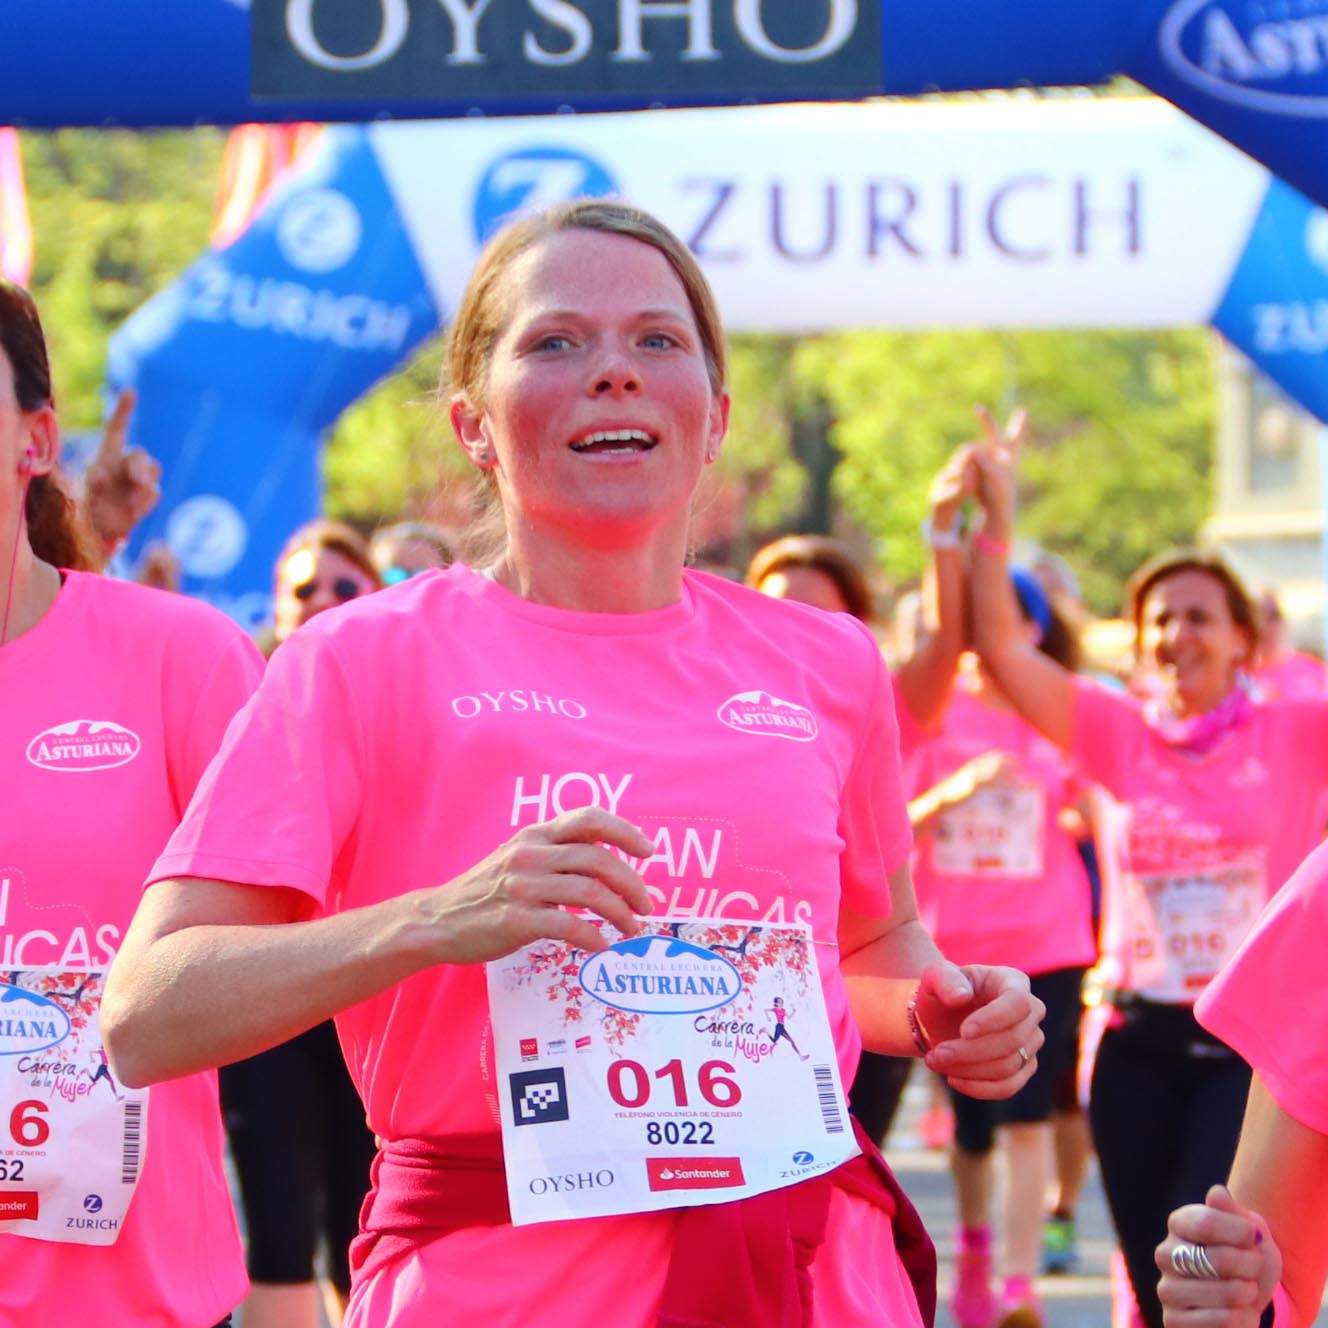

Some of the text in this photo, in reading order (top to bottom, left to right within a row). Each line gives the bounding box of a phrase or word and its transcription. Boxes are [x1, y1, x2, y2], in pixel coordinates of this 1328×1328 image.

[285, 0, 858, 70] OYSHO
[678, 172, 1142, 264] ZURICH
[187, 262, 412, 353] ZURICH
[451, 689, 587, 720] OYSHO
[729, 708, 814, 735] ASTURIANA
[36, 741, 133, 761] ASTURIANA
[510, 772, 632, 827] HOY
[594, 963, 730, 996] ASTURIANA
[694, 1015, 755, 1035] Carrera
[733, 1036, 777, 1063] Mujer
[17, 1056, 77, 1075] Carrera
[50, 1076, 96, 1102] Mujer
[607, 1058, 742, 1109] 016
[647, 1121, 715, 1145] 8022
[529, 1169, 614, 1196] OYSHO
[674, 1168, 731, 1180] Santander
[779, 1160, 836, 1178] ZURICH
[66, 1217, 118, 1230] ZURICH
